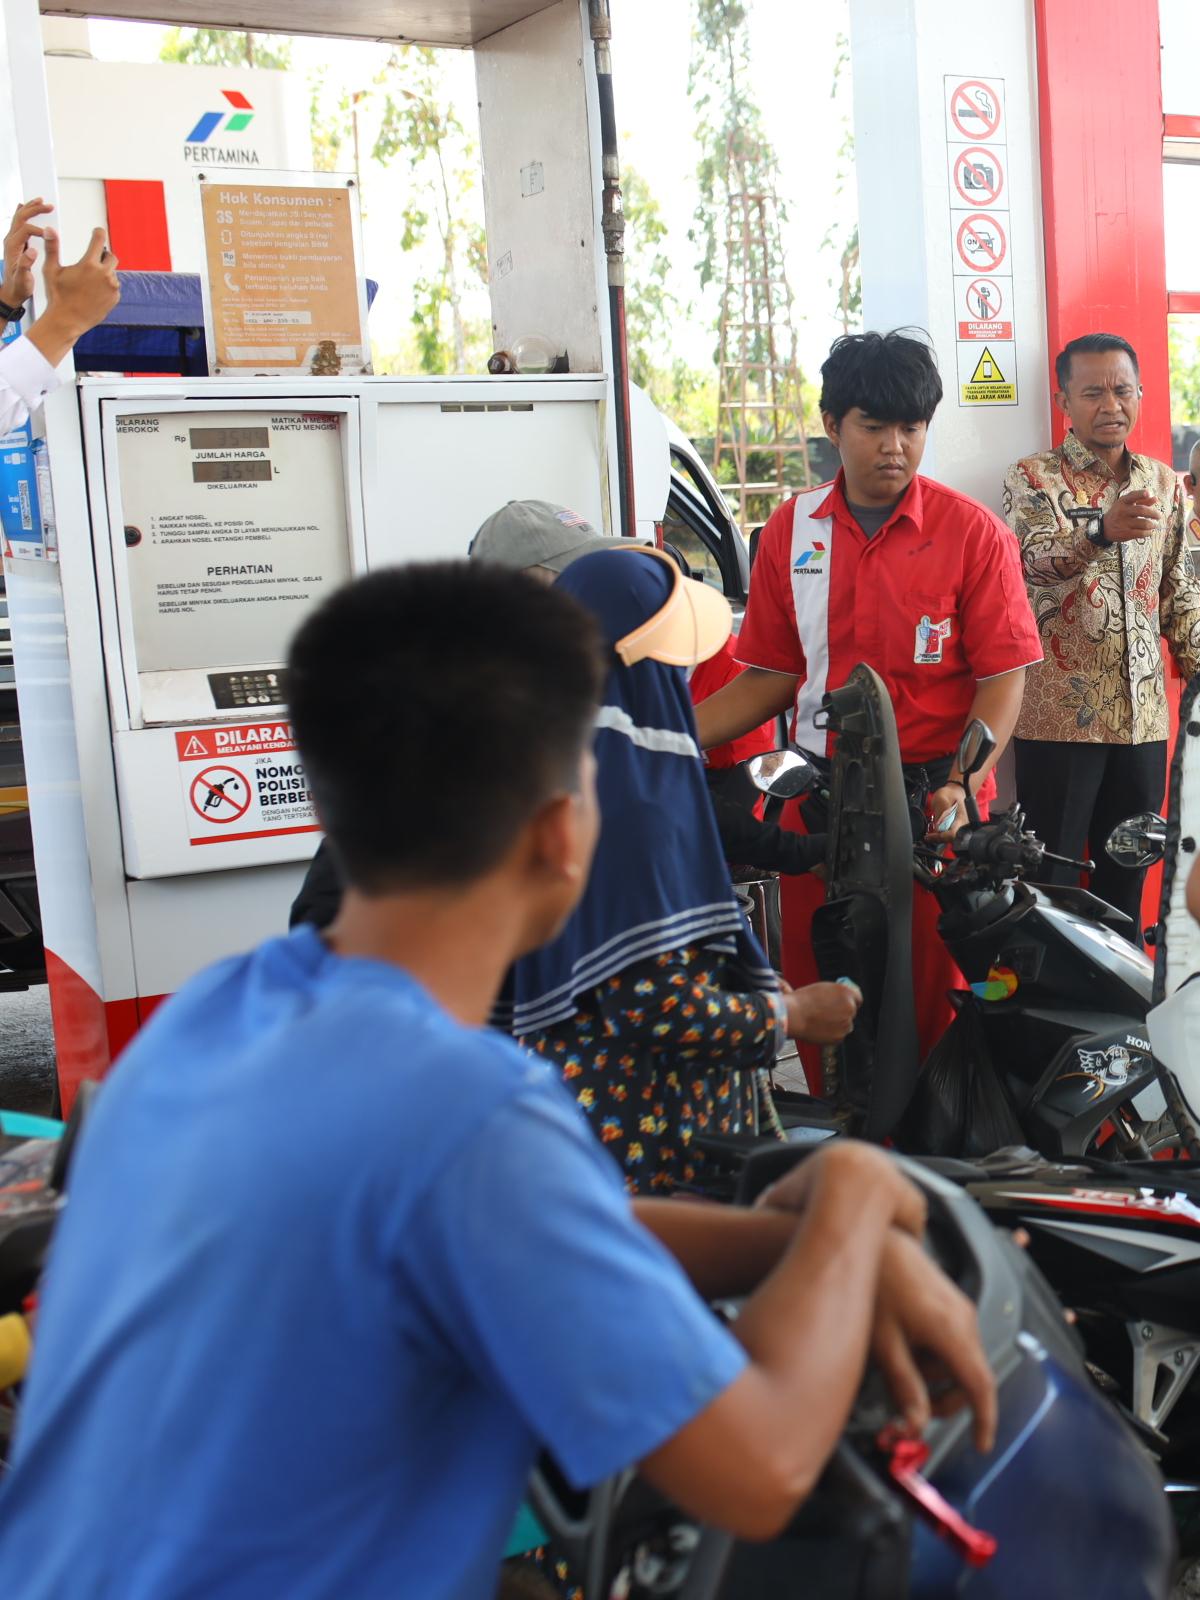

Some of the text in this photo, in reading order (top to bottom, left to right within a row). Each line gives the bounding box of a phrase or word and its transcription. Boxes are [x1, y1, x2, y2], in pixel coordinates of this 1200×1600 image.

[184, 146, 259, 165] PERTAMINA
[219, 192, 249, 205] Hak
[253, 193, 324, 206] Konsumen
[216, 210, 234, 224] 3S
[223, 252, 234, 260] Rp
[174, 435, 187, 443] Rp
[196, 450, 266, 459] JUMLAH HARGA
[207, 564, 273, 576] PERHATIAN
[231, 578, 276, 586] PENGELUARAN
[213, 597, 256, 605] DIKELUARKAN
[214, 726, 294, 746] DILARA
[216, 744, 262, 754] MELAYANI
[255, 757, 272, 765] JIKA
[256, 764, 305, 780] NOMO
[258, 778, 306, 793] POLISI
[259, 790, 314, 807] BERBE
[262, 806, 291, 816] DENGAN
[292, 804, 316, 813] NOMO
[263, 814, 282, 822] YANG
[284, 811, 313, 821] TERTERA
[1126, 1034, 1152, 1050] HON
